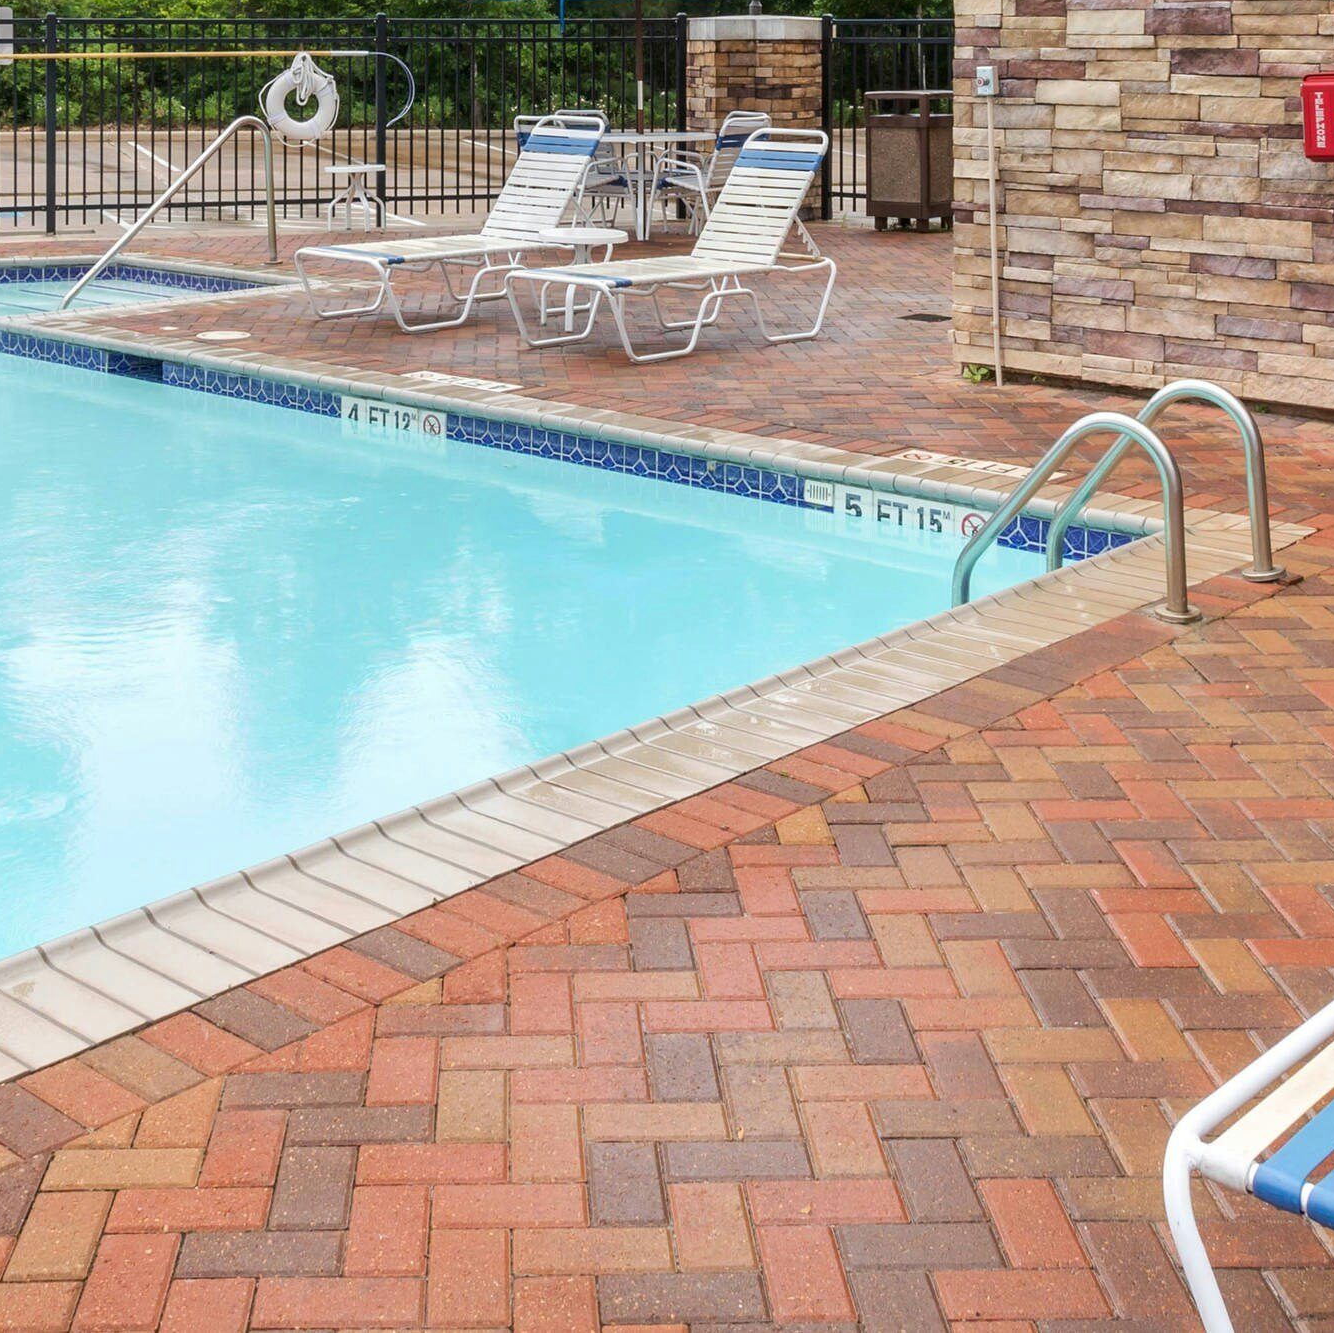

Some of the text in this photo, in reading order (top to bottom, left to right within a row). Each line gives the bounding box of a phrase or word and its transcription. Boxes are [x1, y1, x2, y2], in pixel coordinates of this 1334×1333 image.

[1315, 92, 1326, 148] TELEPHONE
[348, 403, 359, 421] 4
[369, 406, 390, 427] FT
[845, 492, 863, 517] 5
[877, 499, 909, 526] FT
